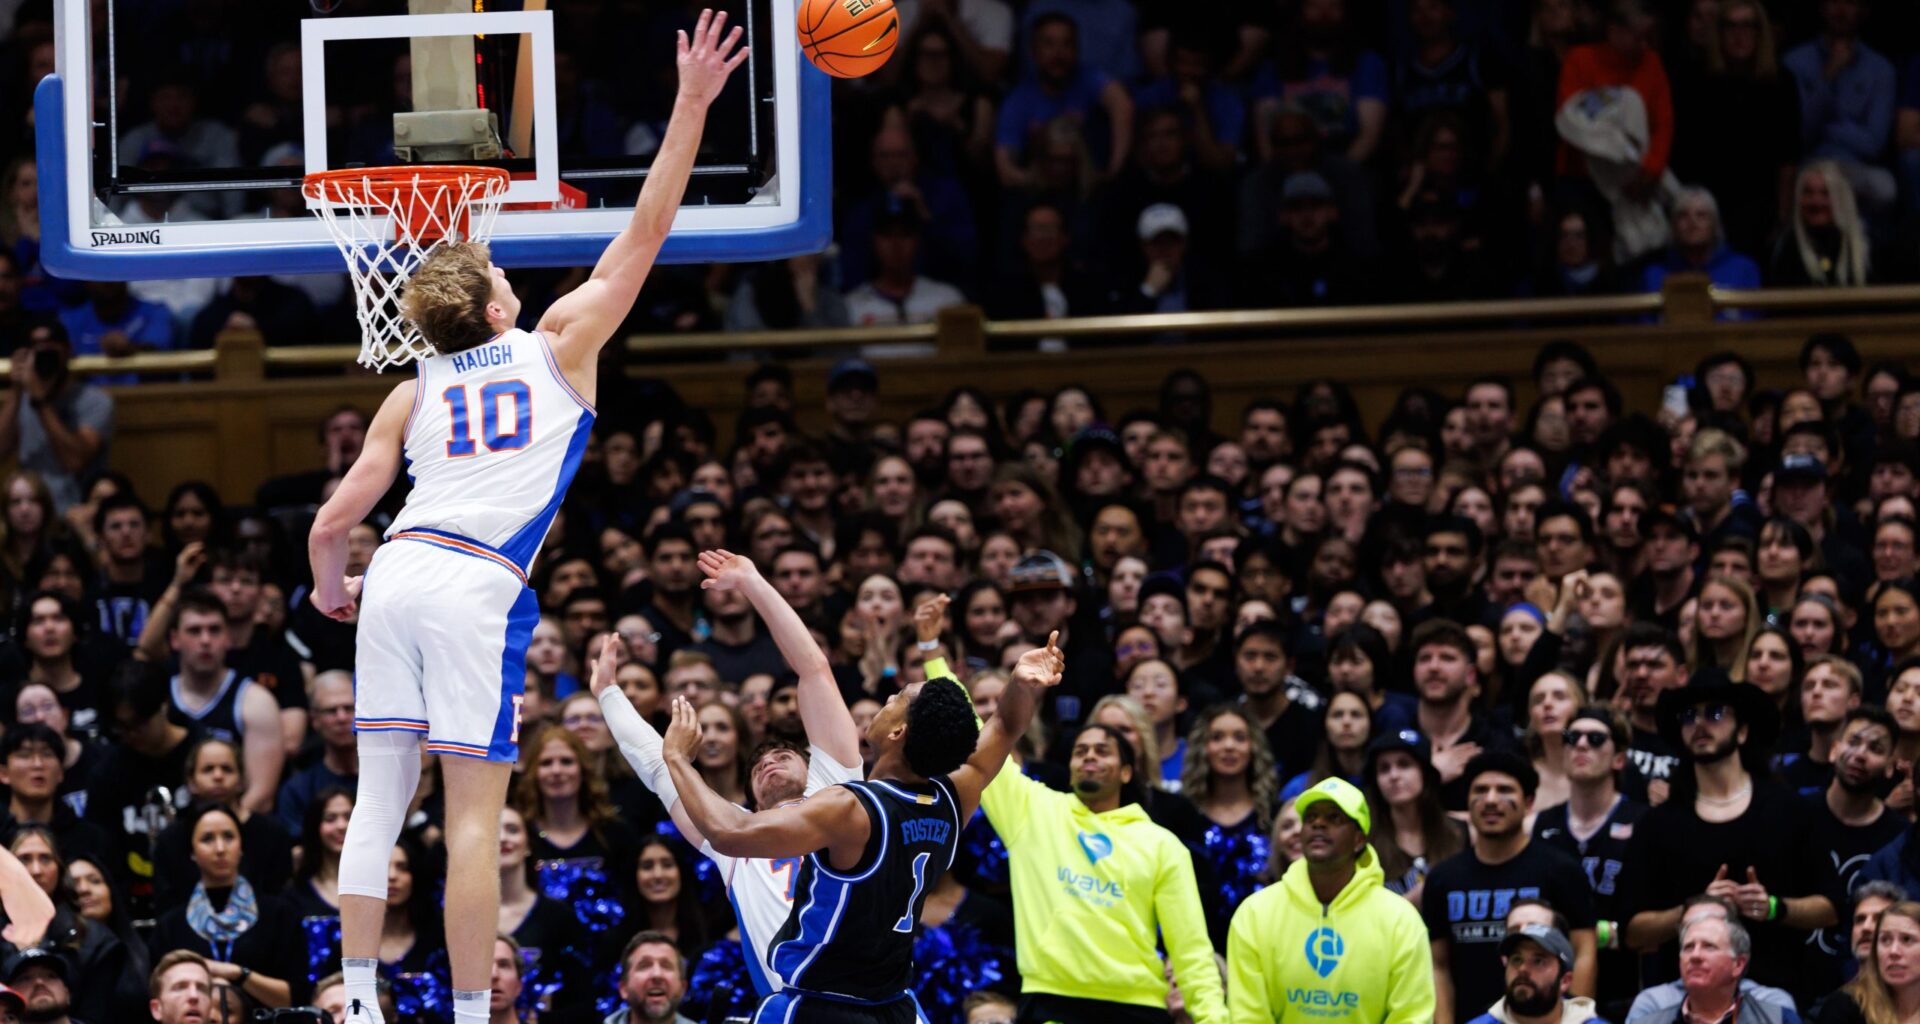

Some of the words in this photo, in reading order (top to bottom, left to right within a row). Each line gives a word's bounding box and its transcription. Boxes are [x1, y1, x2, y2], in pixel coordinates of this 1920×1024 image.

[91, 229, 160, 247] SPALDING
[452, 344, 513, 373] HAUGH
[442, 378, 532, 458] 10
[901, 818, 950, 845] FOSTER
[892, 852, 931, 933] 1
[1057, 866, 1124, 899] wave
[1286, 987, 1359, 1009] wave
